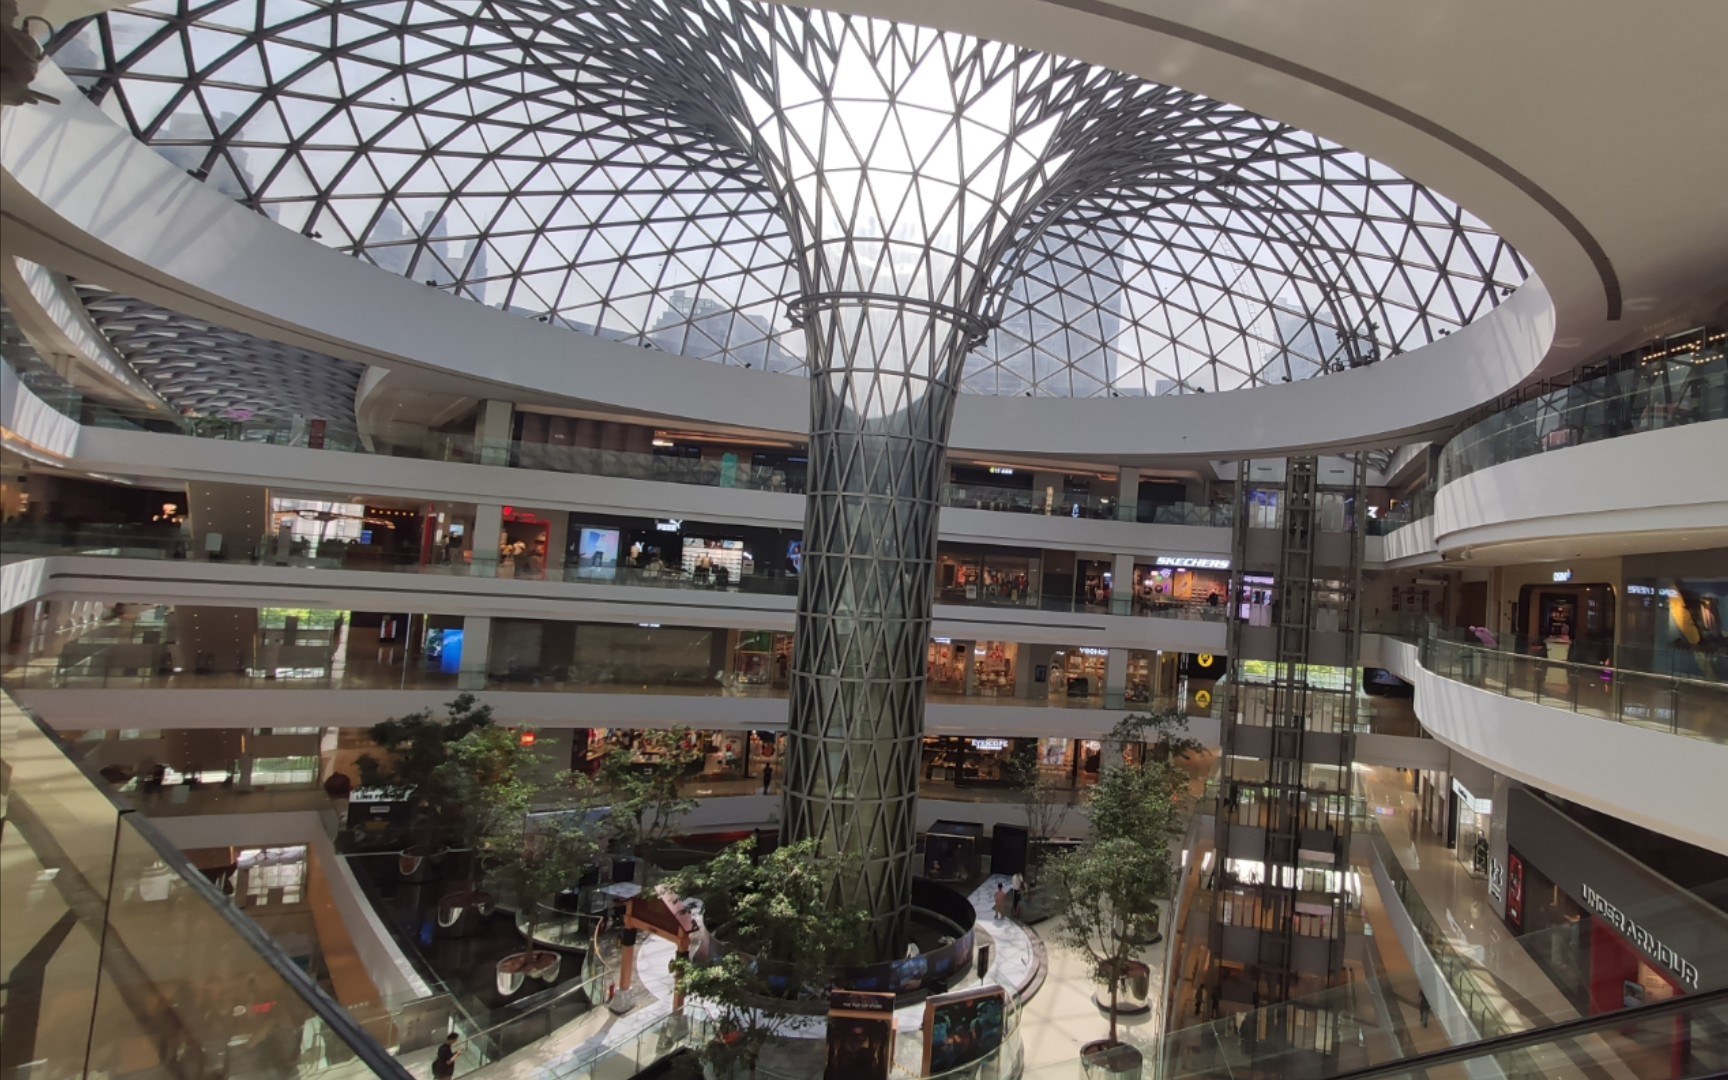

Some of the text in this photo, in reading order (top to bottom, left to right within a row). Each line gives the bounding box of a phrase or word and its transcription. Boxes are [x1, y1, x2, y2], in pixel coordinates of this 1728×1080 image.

[1156, 557, 1230, 569] SKECHERS
[1582, 883, 1698, 989] UNDER ARMOUR
